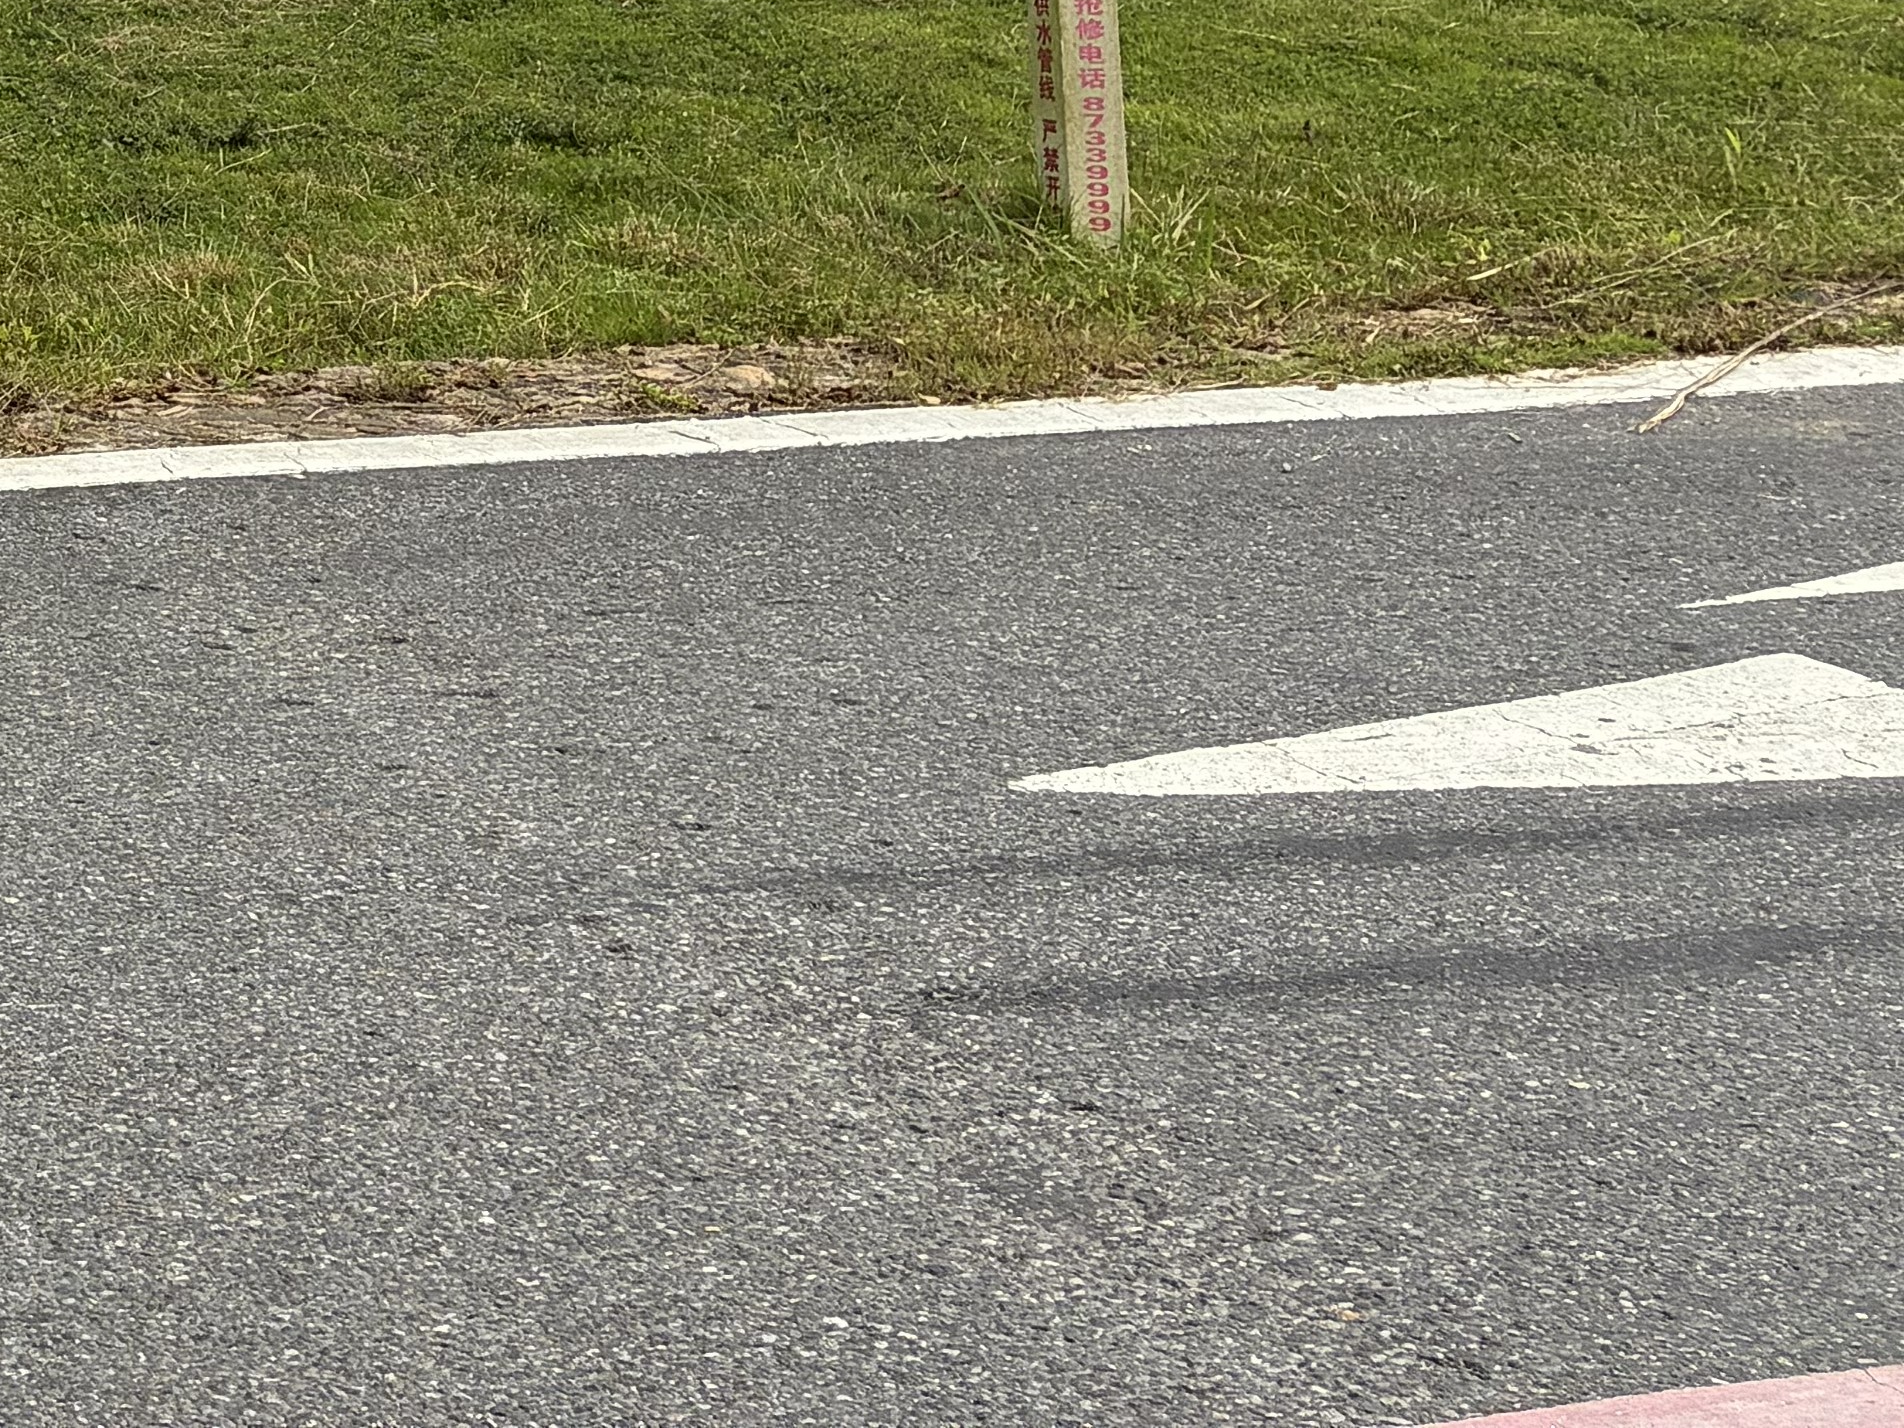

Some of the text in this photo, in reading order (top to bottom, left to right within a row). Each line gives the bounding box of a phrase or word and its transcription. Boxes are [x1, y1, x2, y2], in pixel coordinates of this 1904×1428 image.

[1042, 119, 1060, 212] 严禁开
[1083, 96, 1112, 232] 87339999
